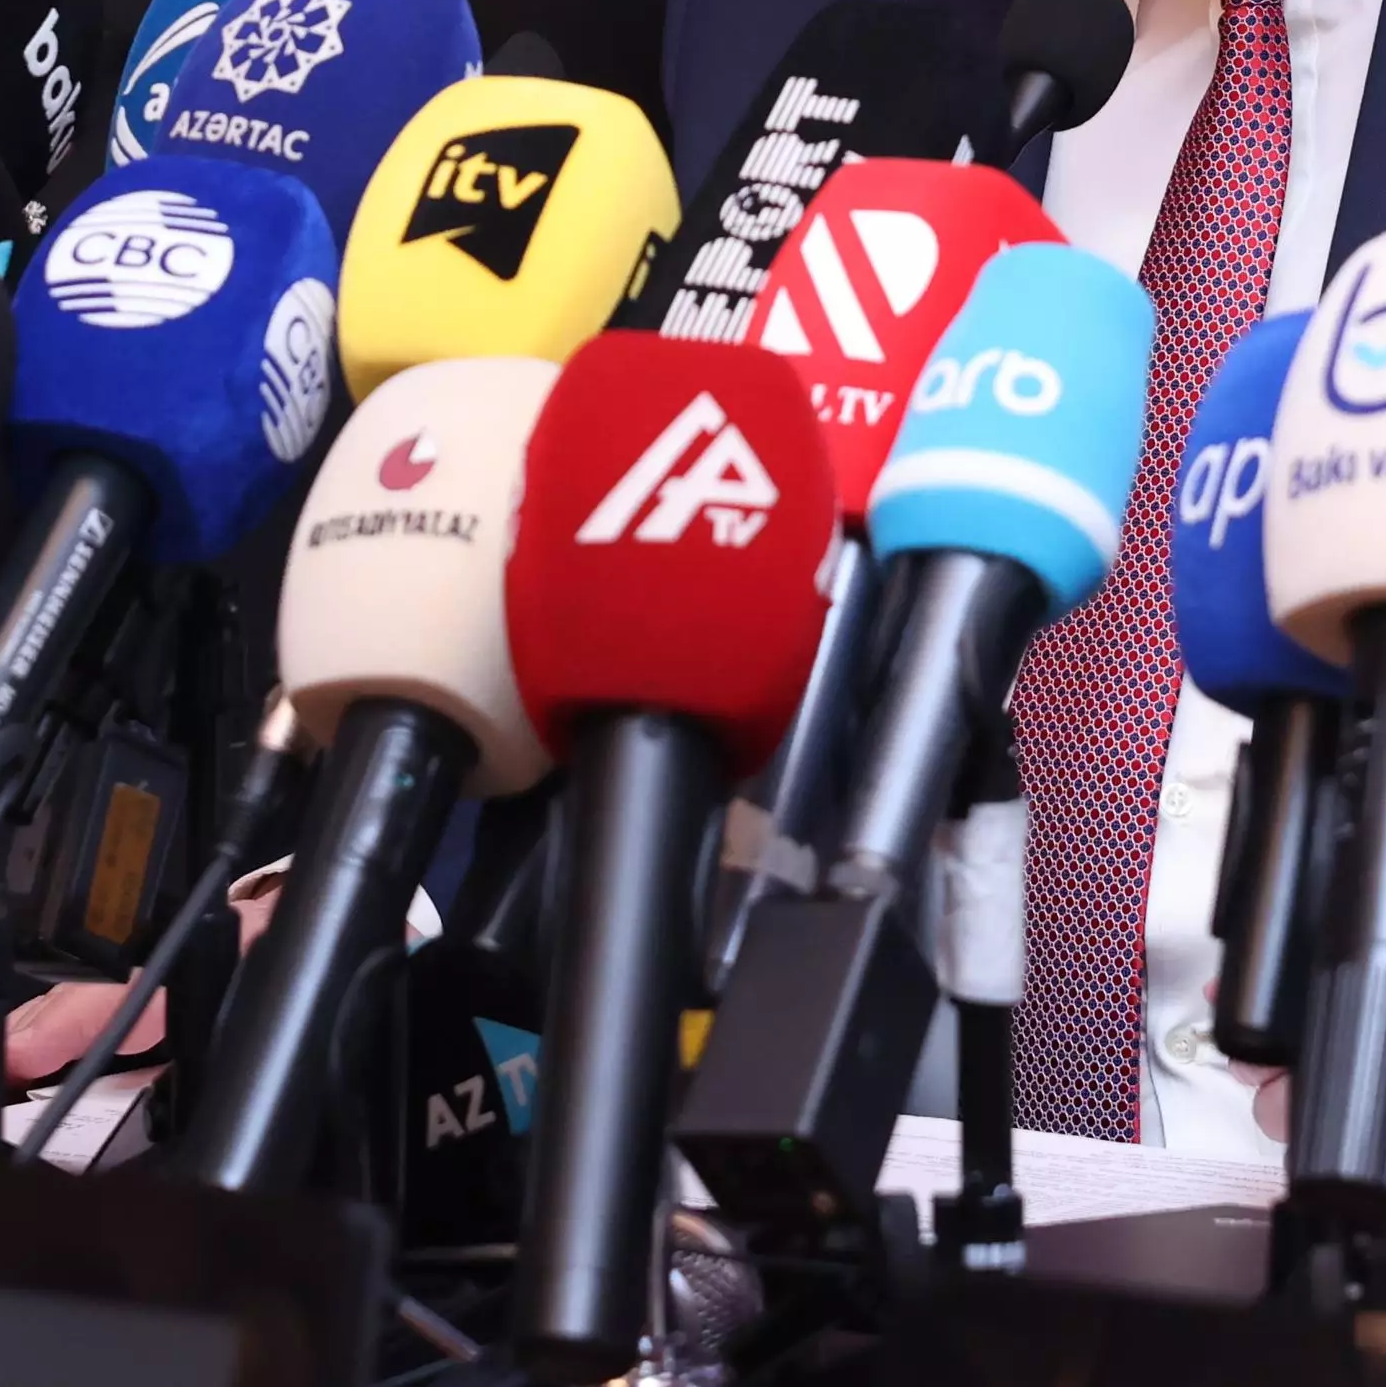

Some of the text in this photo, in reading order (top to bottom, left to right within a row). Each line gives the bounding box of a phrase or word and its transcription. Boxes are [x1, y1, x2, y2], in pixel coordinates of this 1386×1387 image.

[169, 110, 311, 162] AZƏRTAC
[426, 143, 549, 210] itv
[658, 76, 861, 346] EPORT
[72, 231, 207, 279] CBC
[1178, 436, 1273, 550] ap
